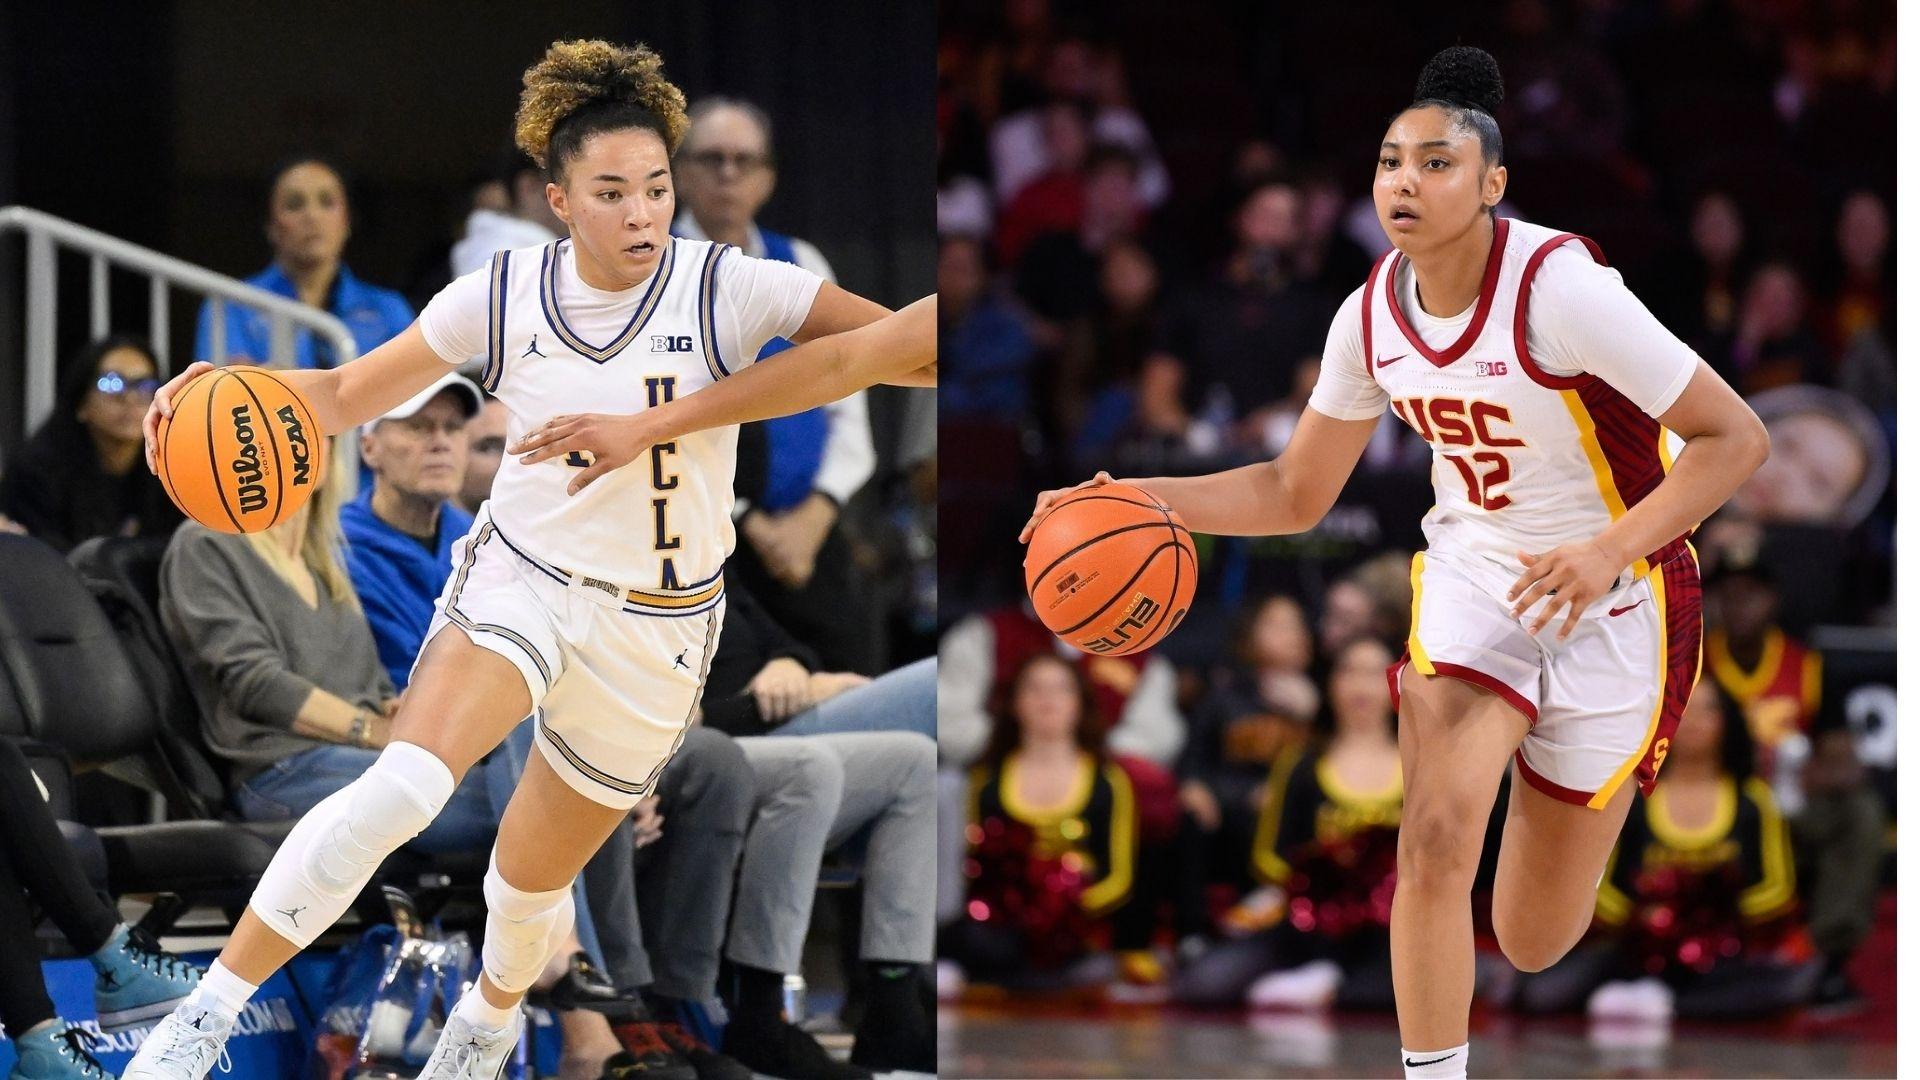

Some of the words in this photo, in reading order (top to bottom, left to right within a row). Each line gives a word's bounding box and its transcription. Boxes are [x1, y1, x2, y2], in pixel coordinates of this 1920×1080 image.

[277, 404, 310, 486] NCAA
[1391, 398, 1527, 447] USC
[231, 404, 268, 514] Wilson
[1442, 452, 1512, 510] 12
[582, 576, 620, 598] BRUINS
[1083, 596, 1160, 653] ELITE
